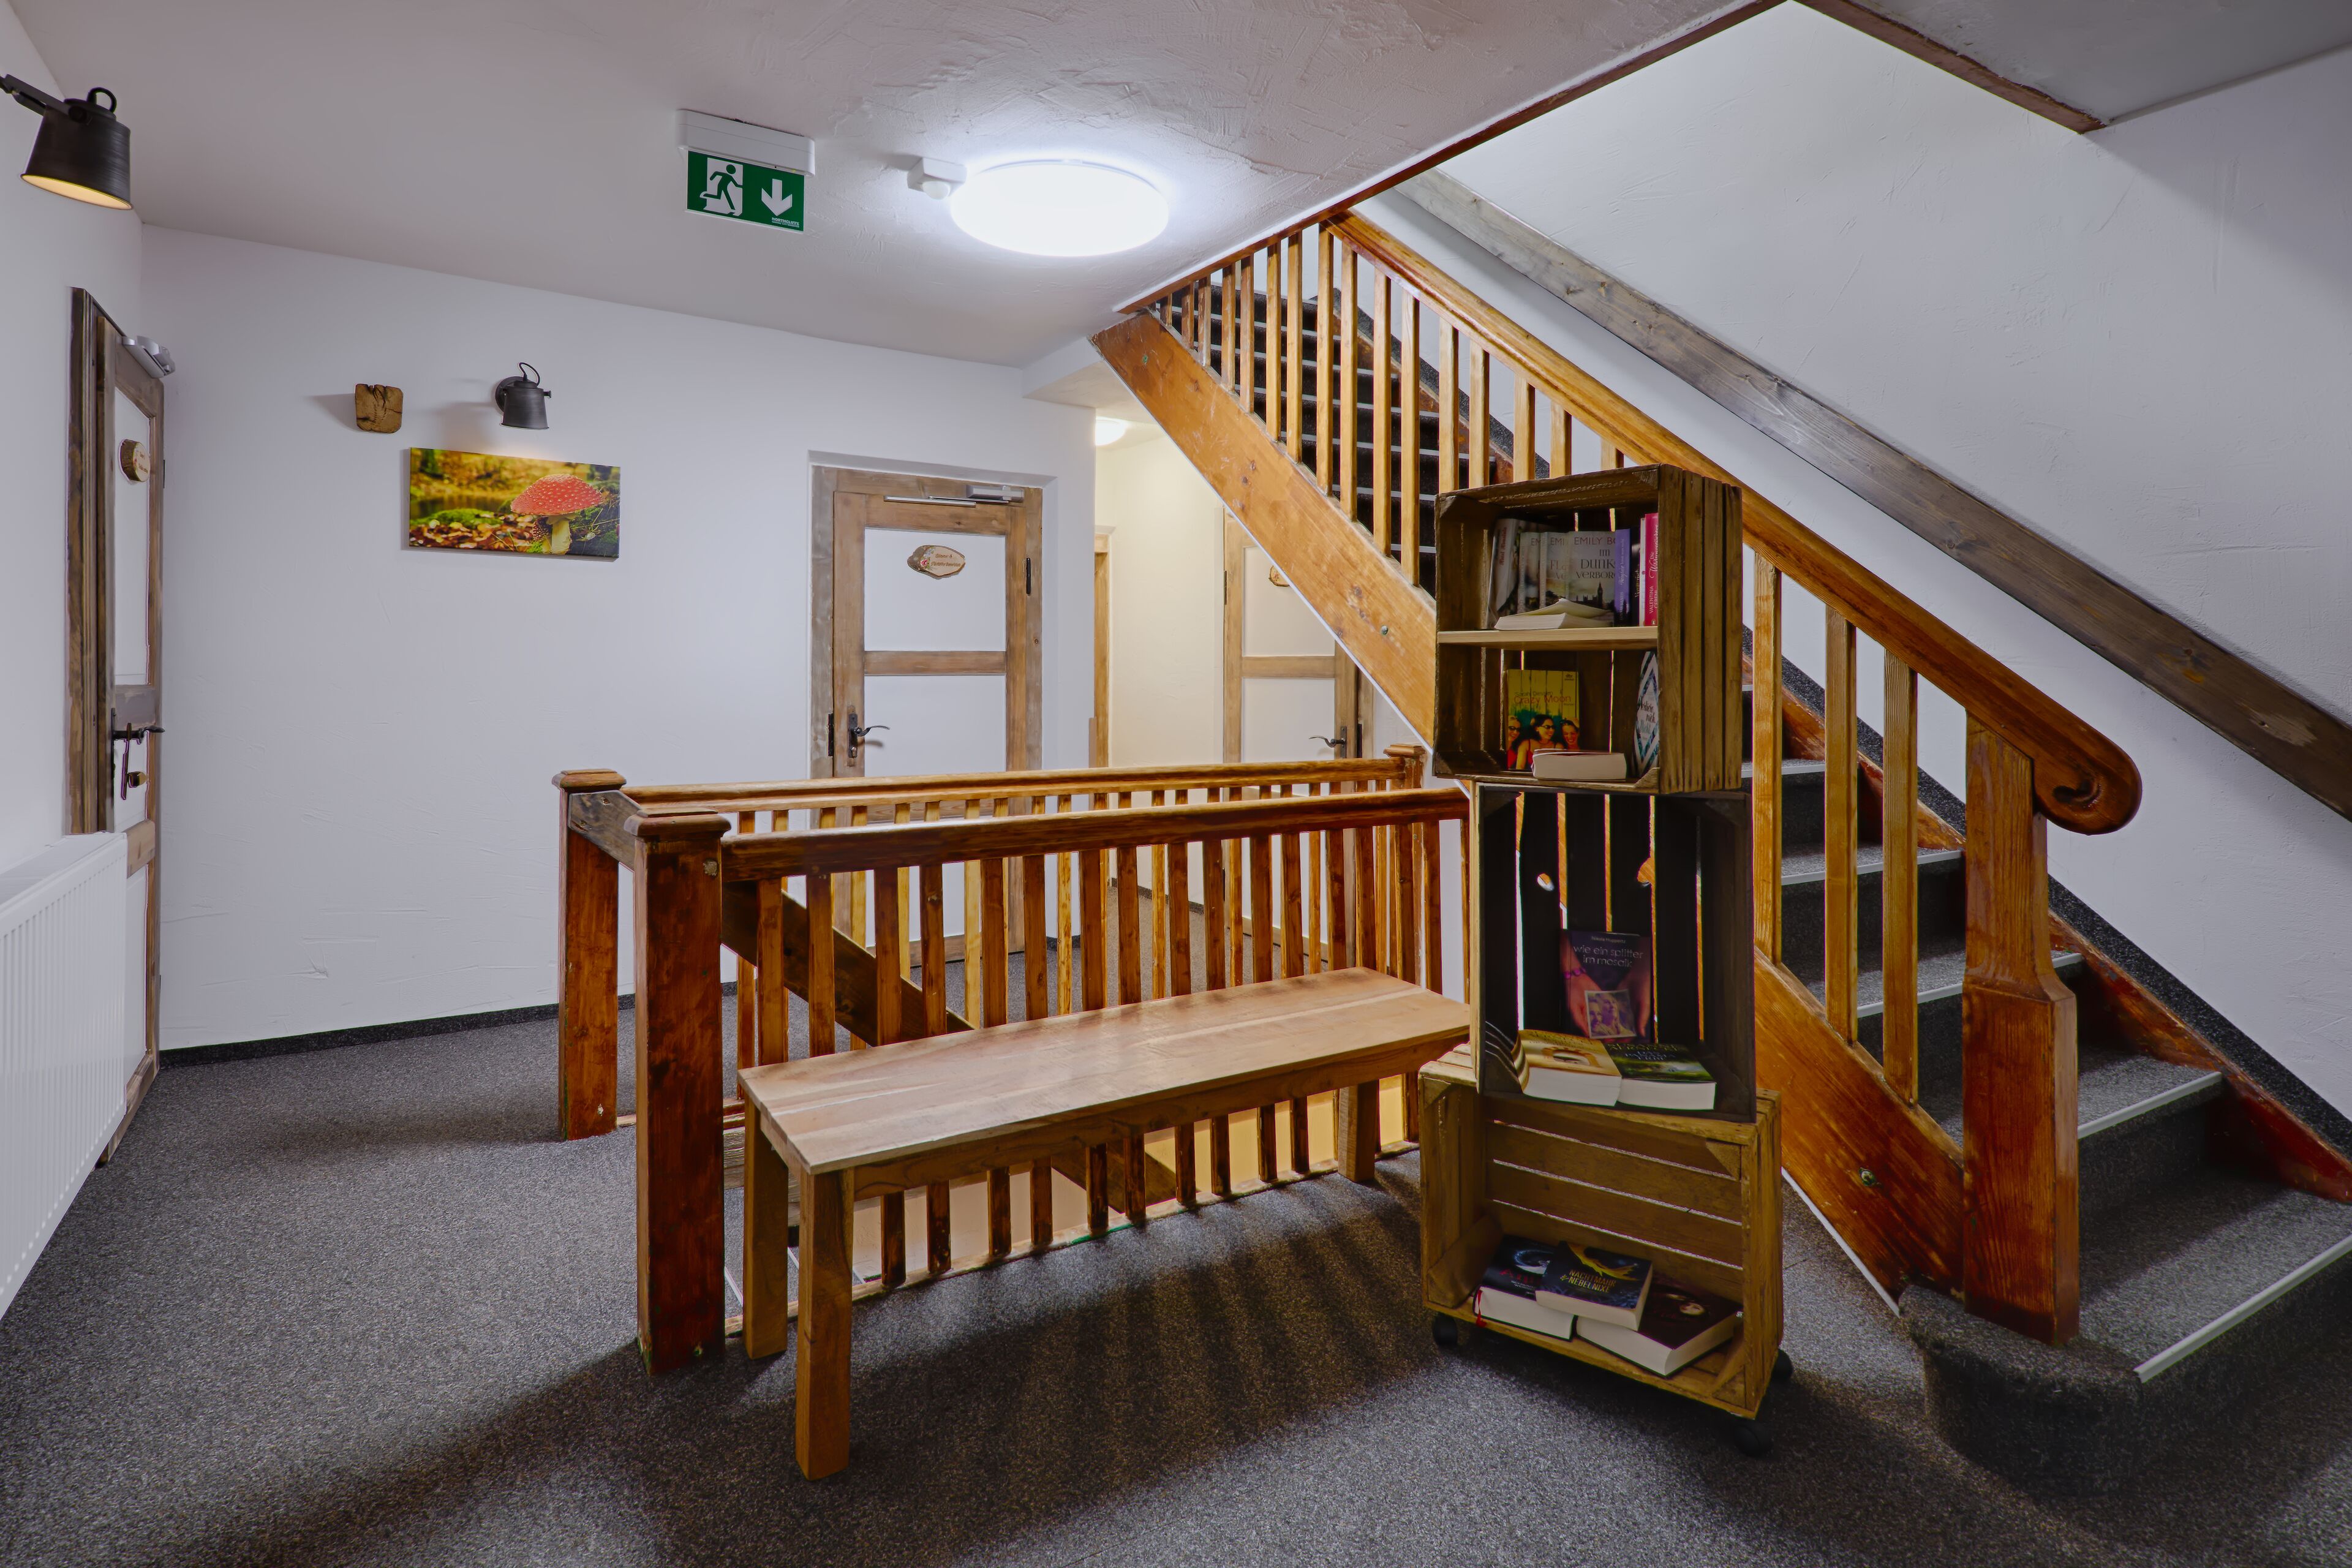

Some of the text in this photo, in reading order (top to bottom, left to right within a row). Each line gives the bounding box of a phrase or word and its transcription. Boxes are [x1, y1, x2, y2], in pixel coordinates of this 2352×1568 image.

[1574, 537, 1602, 546] EMILY
[1581, 559, 1615, 569] DUNK
[1513, 695, 1572, 705] Crazy Moon
[1573, 944, 1644, 959] wie ein splitter
[1583, 954, 1632, 968] im mosaik
